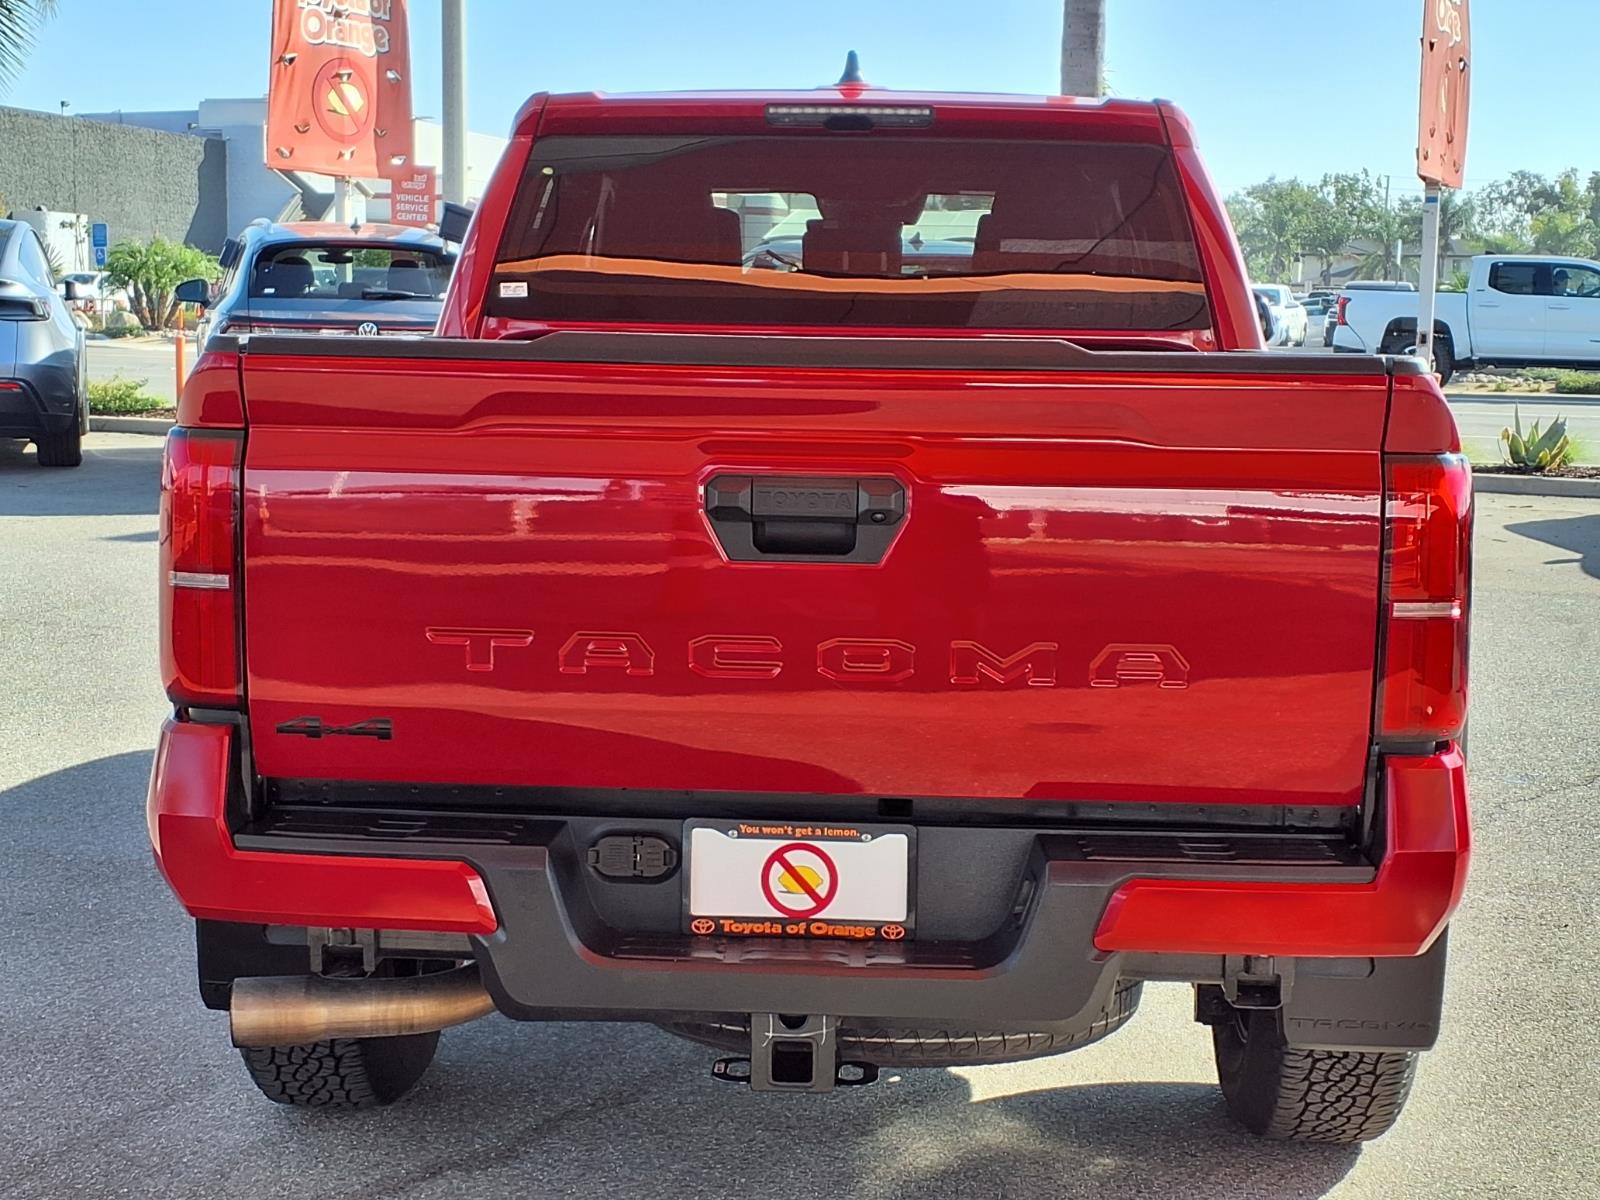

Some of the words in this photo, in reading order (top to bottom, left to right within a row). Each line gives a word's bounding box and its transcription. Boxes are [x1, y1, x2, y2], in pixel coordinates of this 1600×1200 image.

[301, 5, 390, 57] Orange
[396, 193, 430, 203] VEHICLE
[396, 202, 430, 212] SERVICE
[397, 212, 428, 221] CENTER
[758, 489, 851, 511] TOYOTA
[425, 626, 1190, 689] TACOMA
[740, 824, 760, 834] You
[762, 826, 793, 835] won't
[795, 826, 812, 837] get
[815, 828, 822, 836] a
[824, 827, 860, 837] lemon.
[719, 919, 783, 934] Toyota
[786, 922, 807, 934] of
[810, 921, 876, 938] Orange
